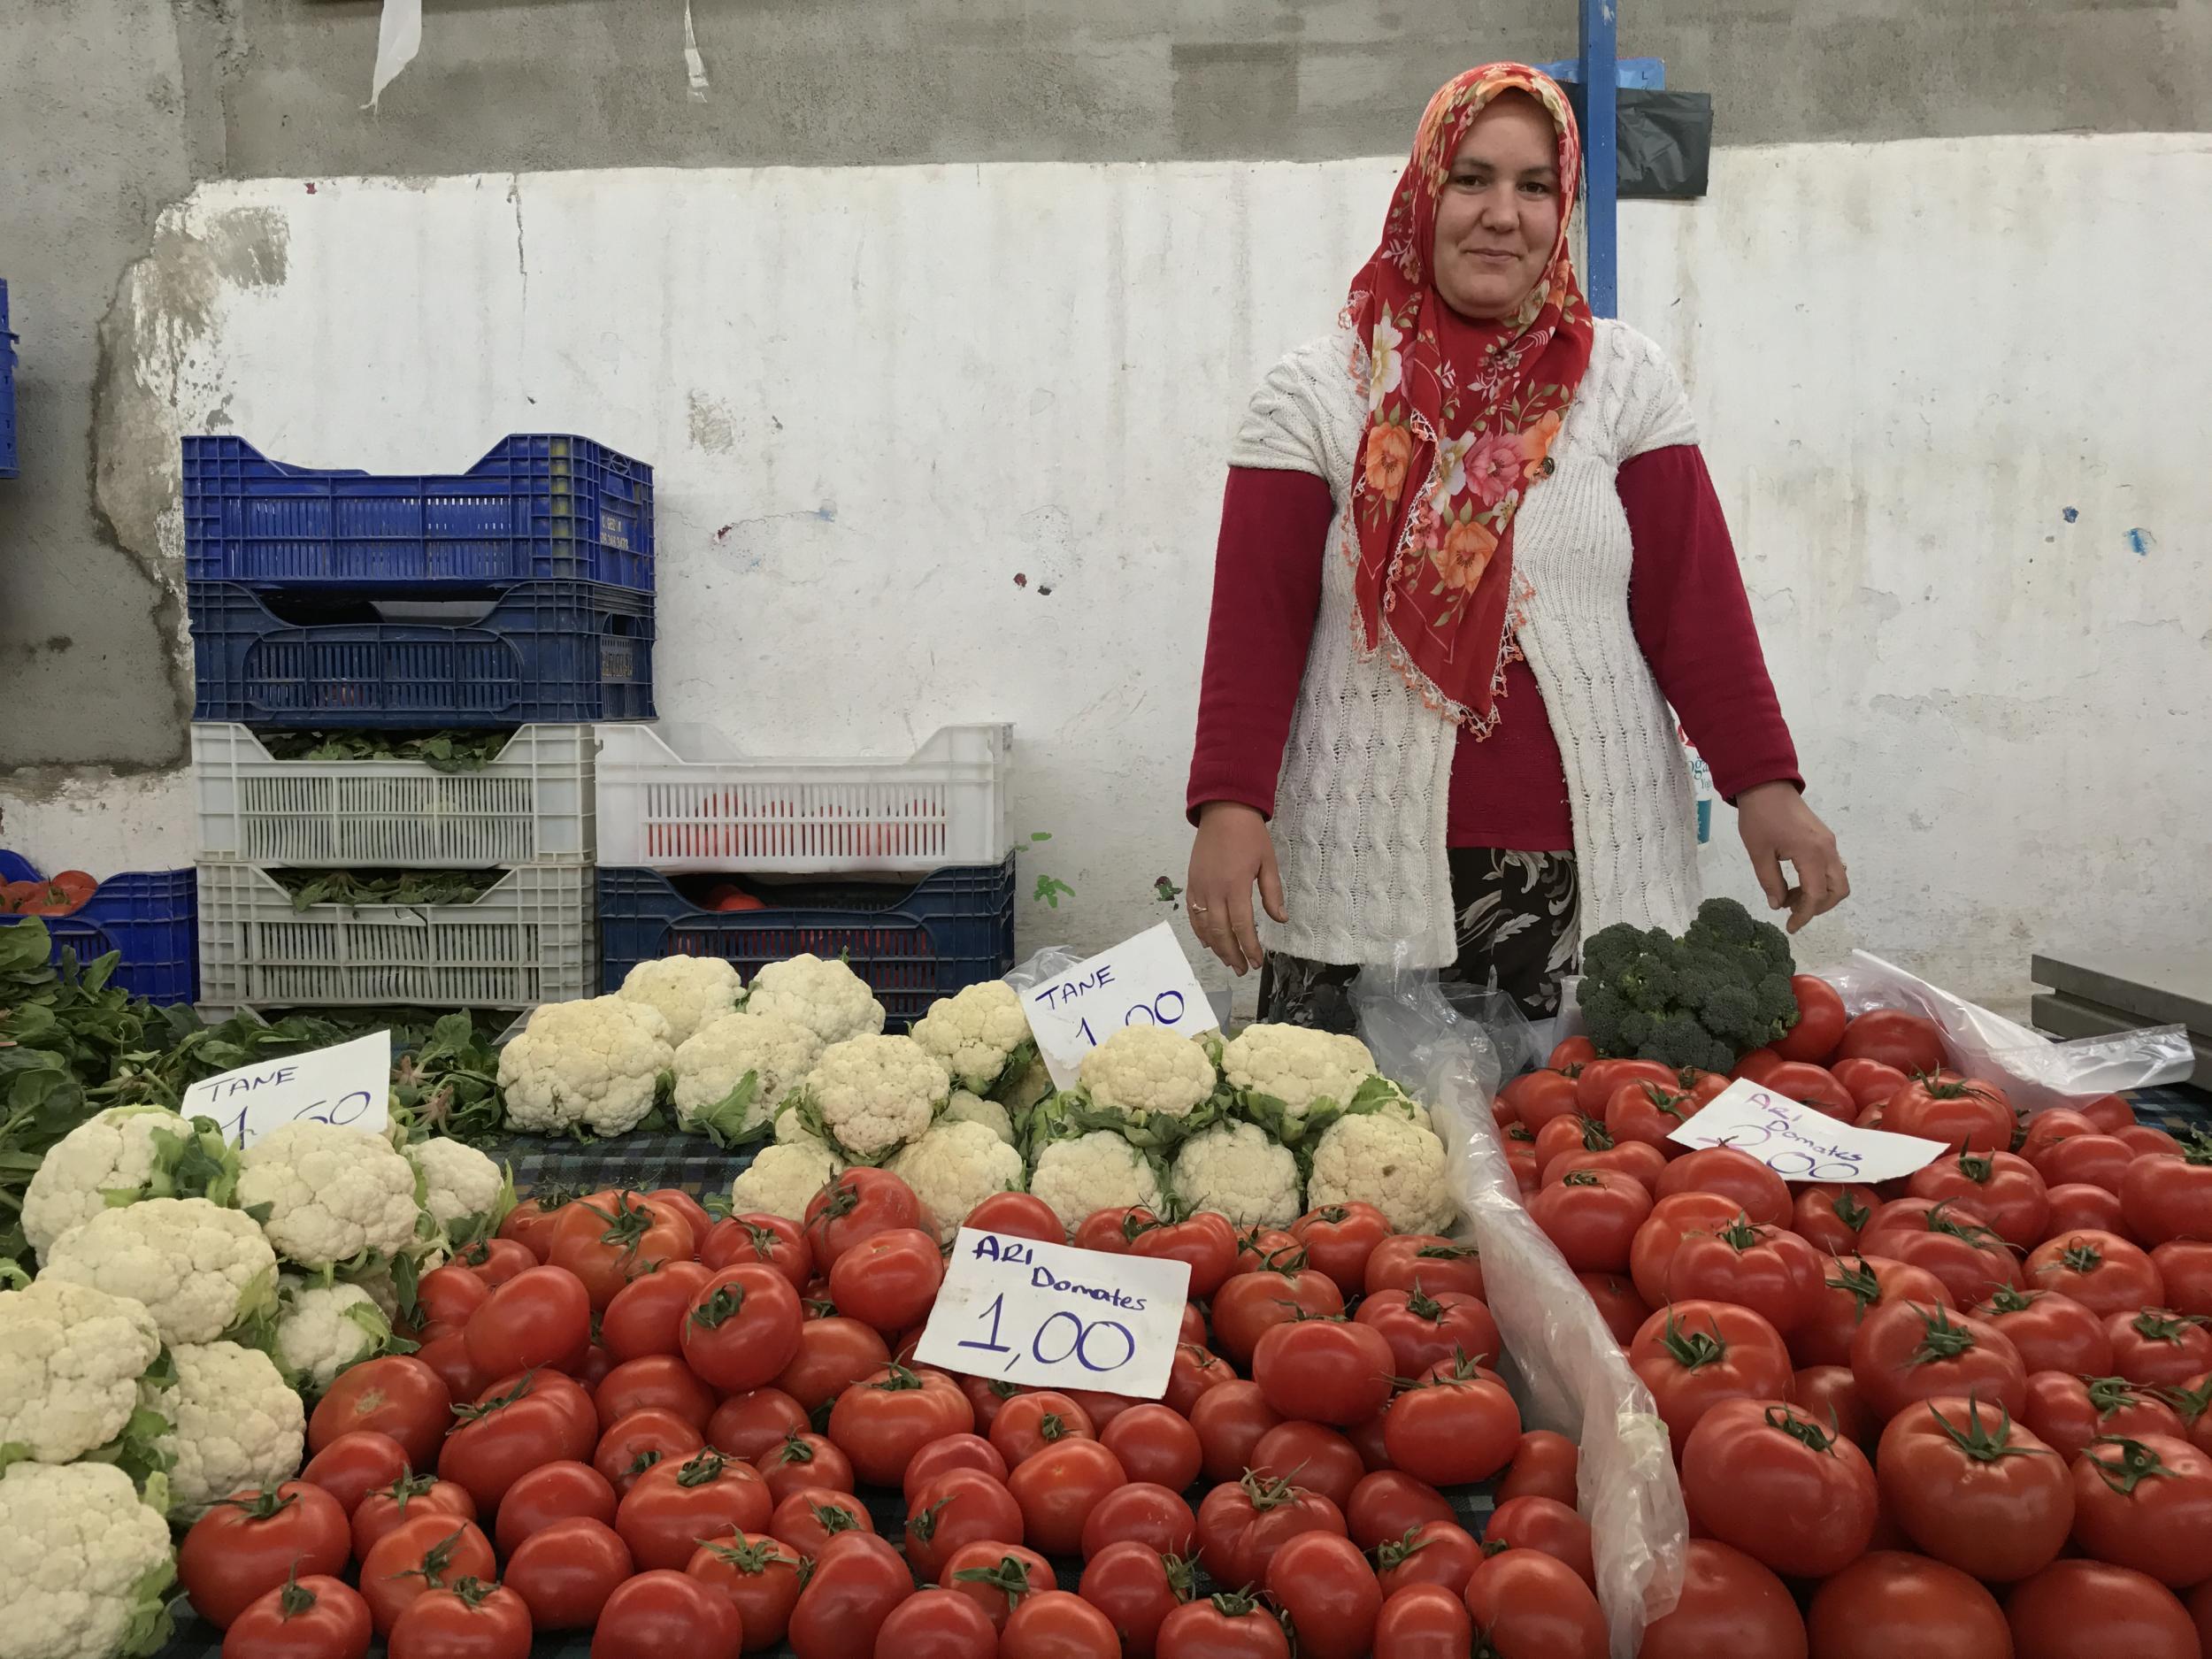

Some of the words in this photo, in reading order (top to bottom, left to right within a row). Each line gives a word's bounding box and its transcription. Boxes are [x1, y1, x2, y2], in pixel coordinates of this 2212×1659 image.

[1035, 965, 1116, 1010] TANE
[198, 1066, 298, 1102] TANE
[1765, 1119, 1863, 1162] Domates
[972, 1234, 1033, 1265] ARI
[1031, 1266, 1148, 1311] Domates
[957, 1292, 1135, 1372] 1,00
